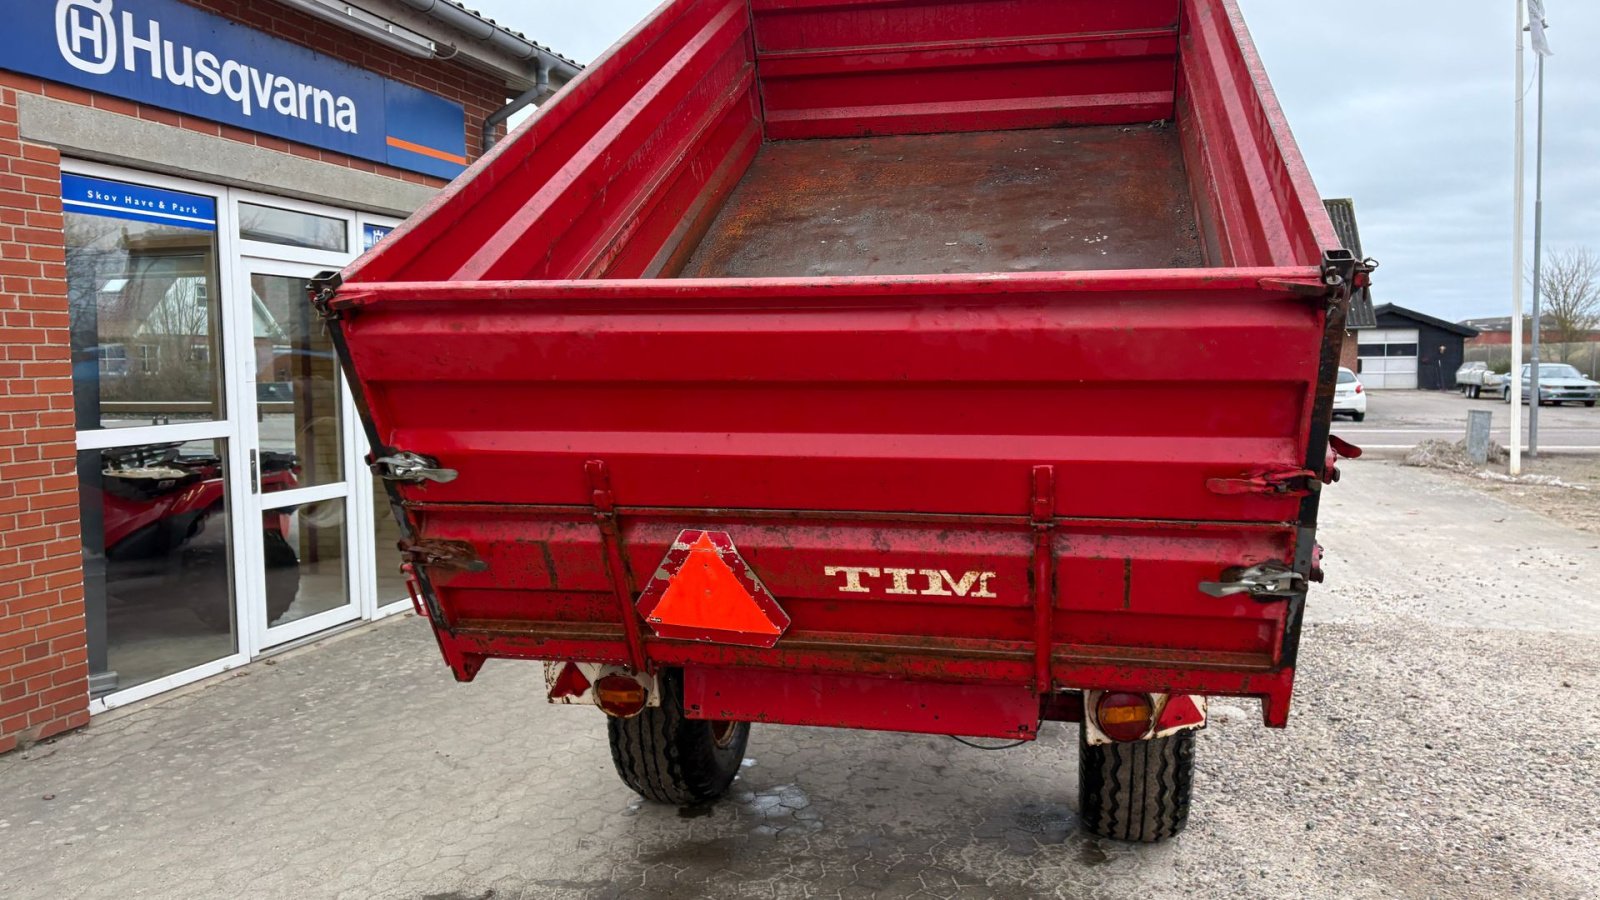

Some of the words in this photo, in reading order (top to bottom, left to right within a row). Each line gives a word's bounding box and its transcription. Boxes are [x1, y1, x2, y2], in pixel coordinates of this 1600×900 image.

[121, 10, 358, 135] Husqvarna
[87, 190, 117, 202] Skov
[124, 195, 154, 208] Have
[158, 201, 165, 210] &
[172, 202, 198, 214] Park
[824, 565, 997, 598] TIM
